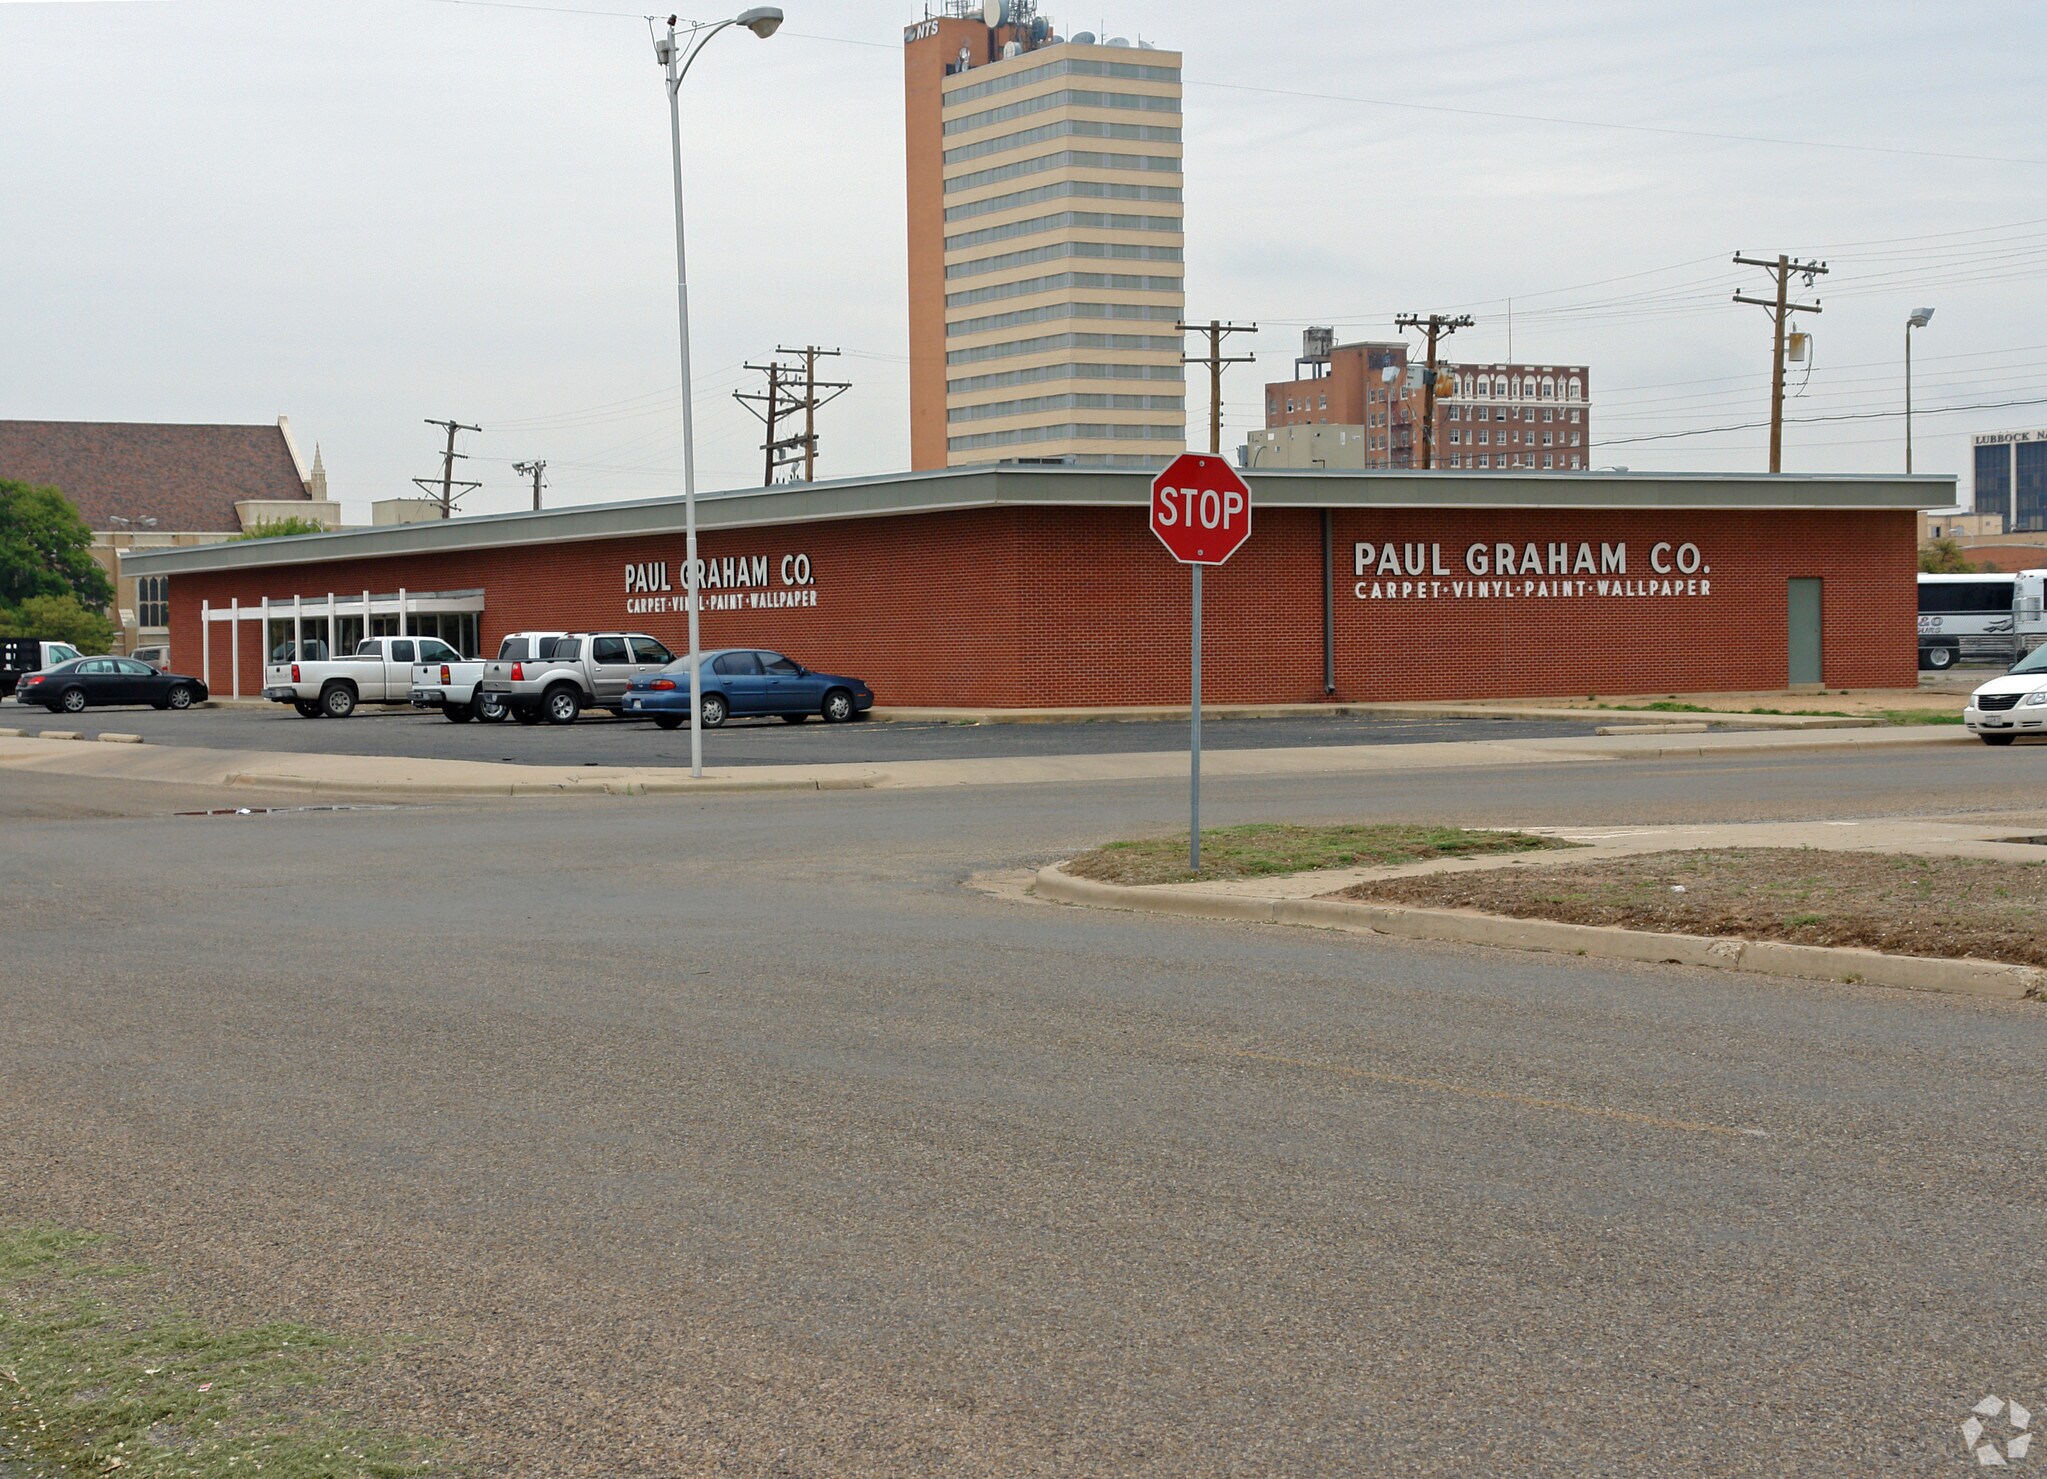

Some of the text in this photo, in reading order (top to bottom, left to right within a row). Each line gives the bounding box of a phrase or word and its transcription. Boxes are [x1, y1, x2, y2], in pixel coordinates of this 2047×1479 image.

[916, 20, 938, 40] NTS
[1975, 432, 2030, 445] LUBBOCK
[1158, 486, 1243, 529] STOP
[1354, 542, 1711, 576] PAUL GRAHAM CO.
[625, 553, 815, 593] PAUL GRAHAM CO.
[1354, 580, 1711, 599] CARPET VINYL PAINT WALLPAPER
[627, 590, 817, 613] CARPET VINL PAINT WALLPAPER
